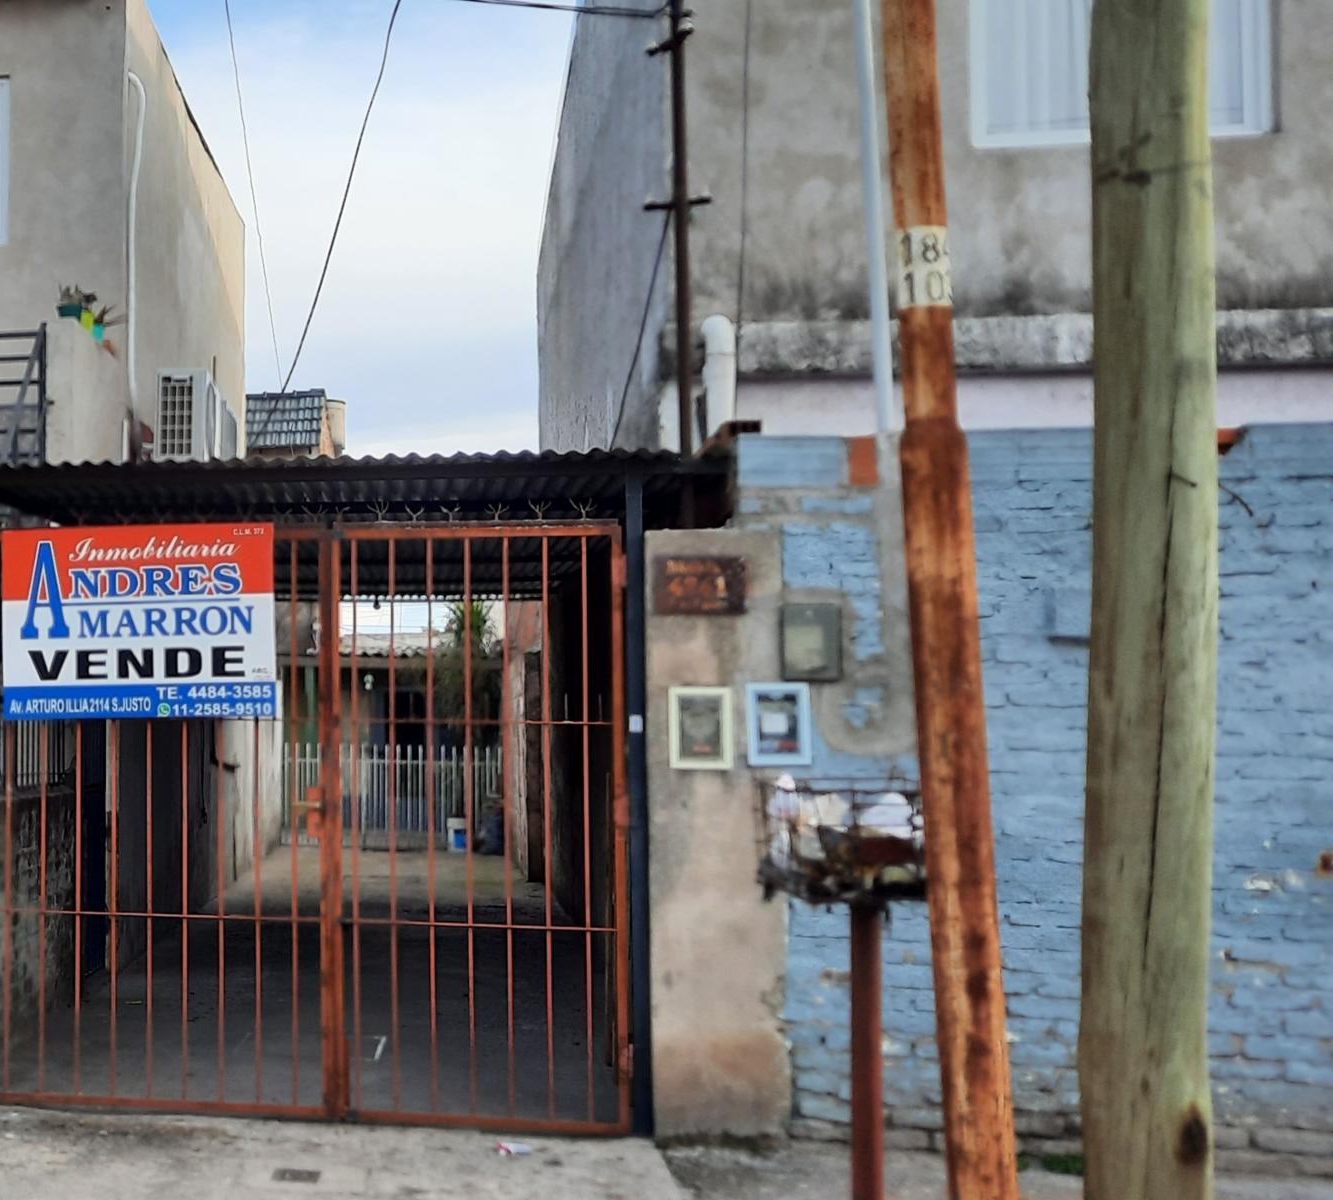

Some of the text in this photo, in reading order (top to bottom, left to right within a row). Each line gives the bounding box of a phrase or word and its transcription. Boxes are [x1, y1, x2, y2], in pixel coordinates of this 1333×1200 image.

[69, 536, 240, 561] Inmobiliaria
[20, 541, 242, 639] ANDRES
[77, 606, 254, 638] MARRON
[28, 646, 246, 680] VENDE
[156, 685, 272, 700] TE. 4484-3585
[9, 699, 24, 714] Av.
[25, 698, 64, 713] ARTURO
[89, 698, 109, 712] 2114
[172, 703, 272, 716] 11-2585-9510
